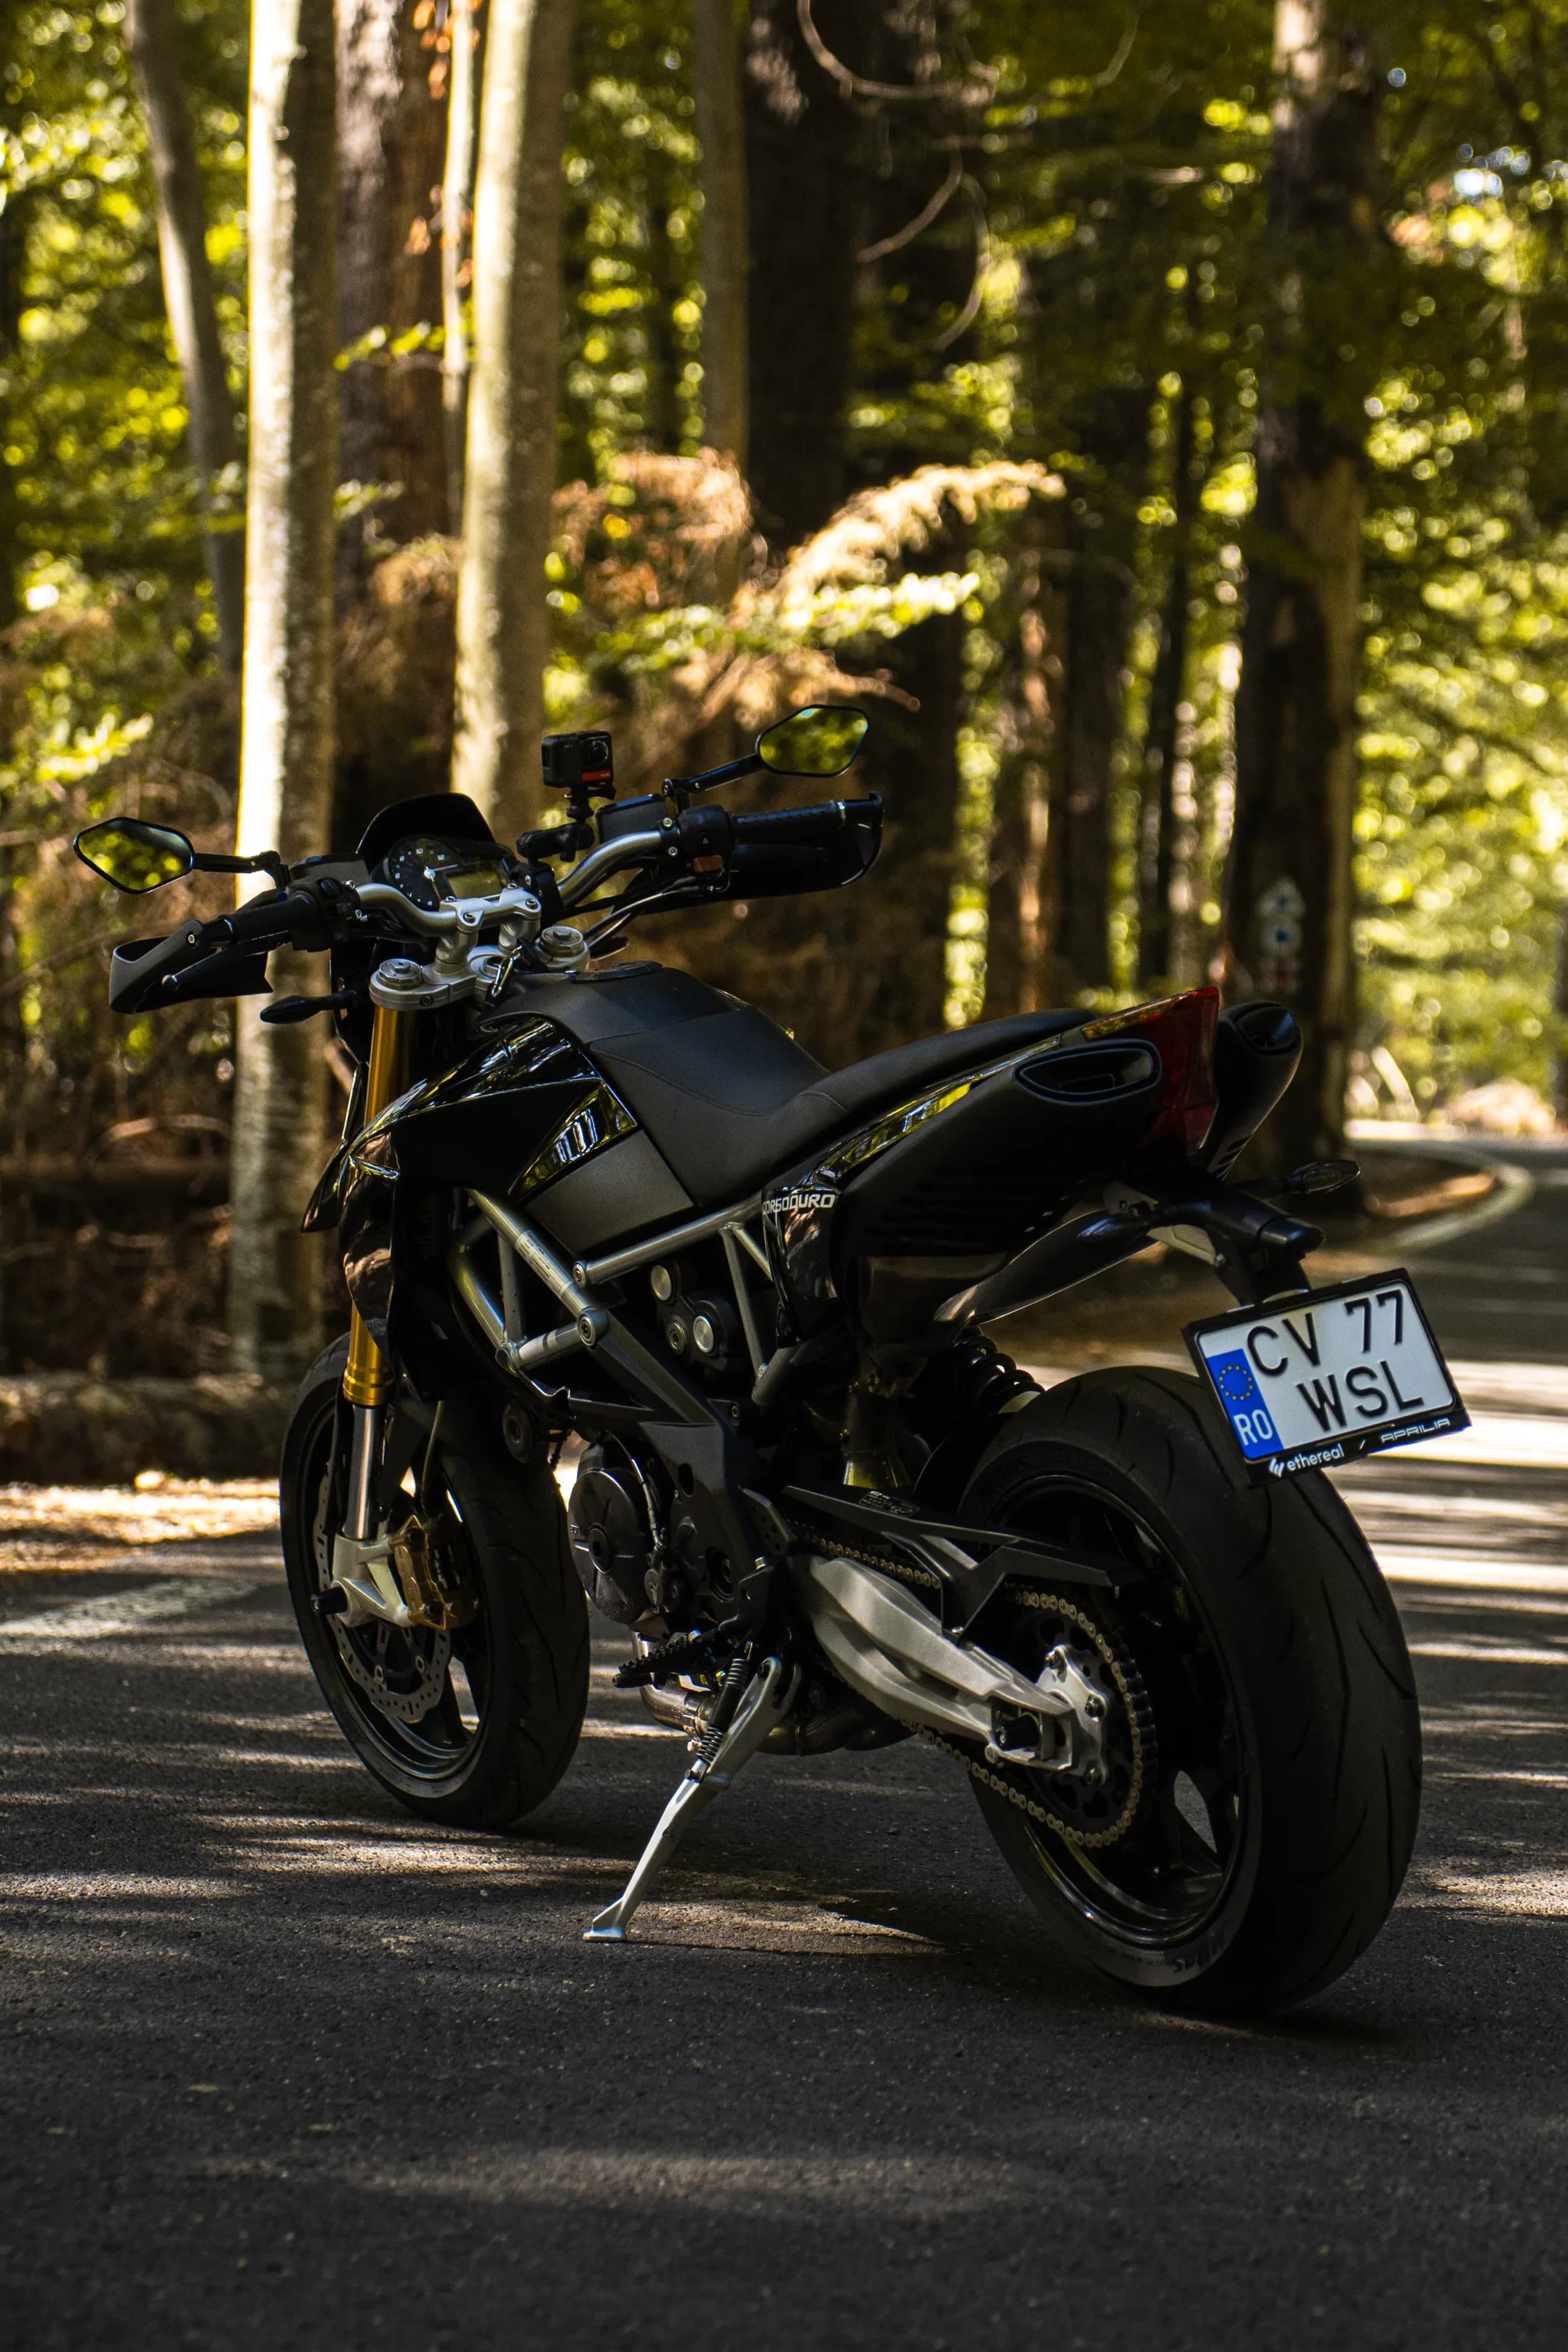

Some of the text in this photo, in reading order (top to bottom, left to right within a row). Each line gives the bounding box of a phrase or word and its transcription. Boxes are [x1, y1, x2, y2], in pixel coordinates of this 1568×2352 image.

[1247, 1290, 1402, 1376] CV 77
[1296, 1360, 1424, 1431] WSL
[1234, 1410, 1273, 1445] RO
[1287, 1443, 1345, 1471] ethereal
[1380, 1417, 1451, 1444] APRILIA
